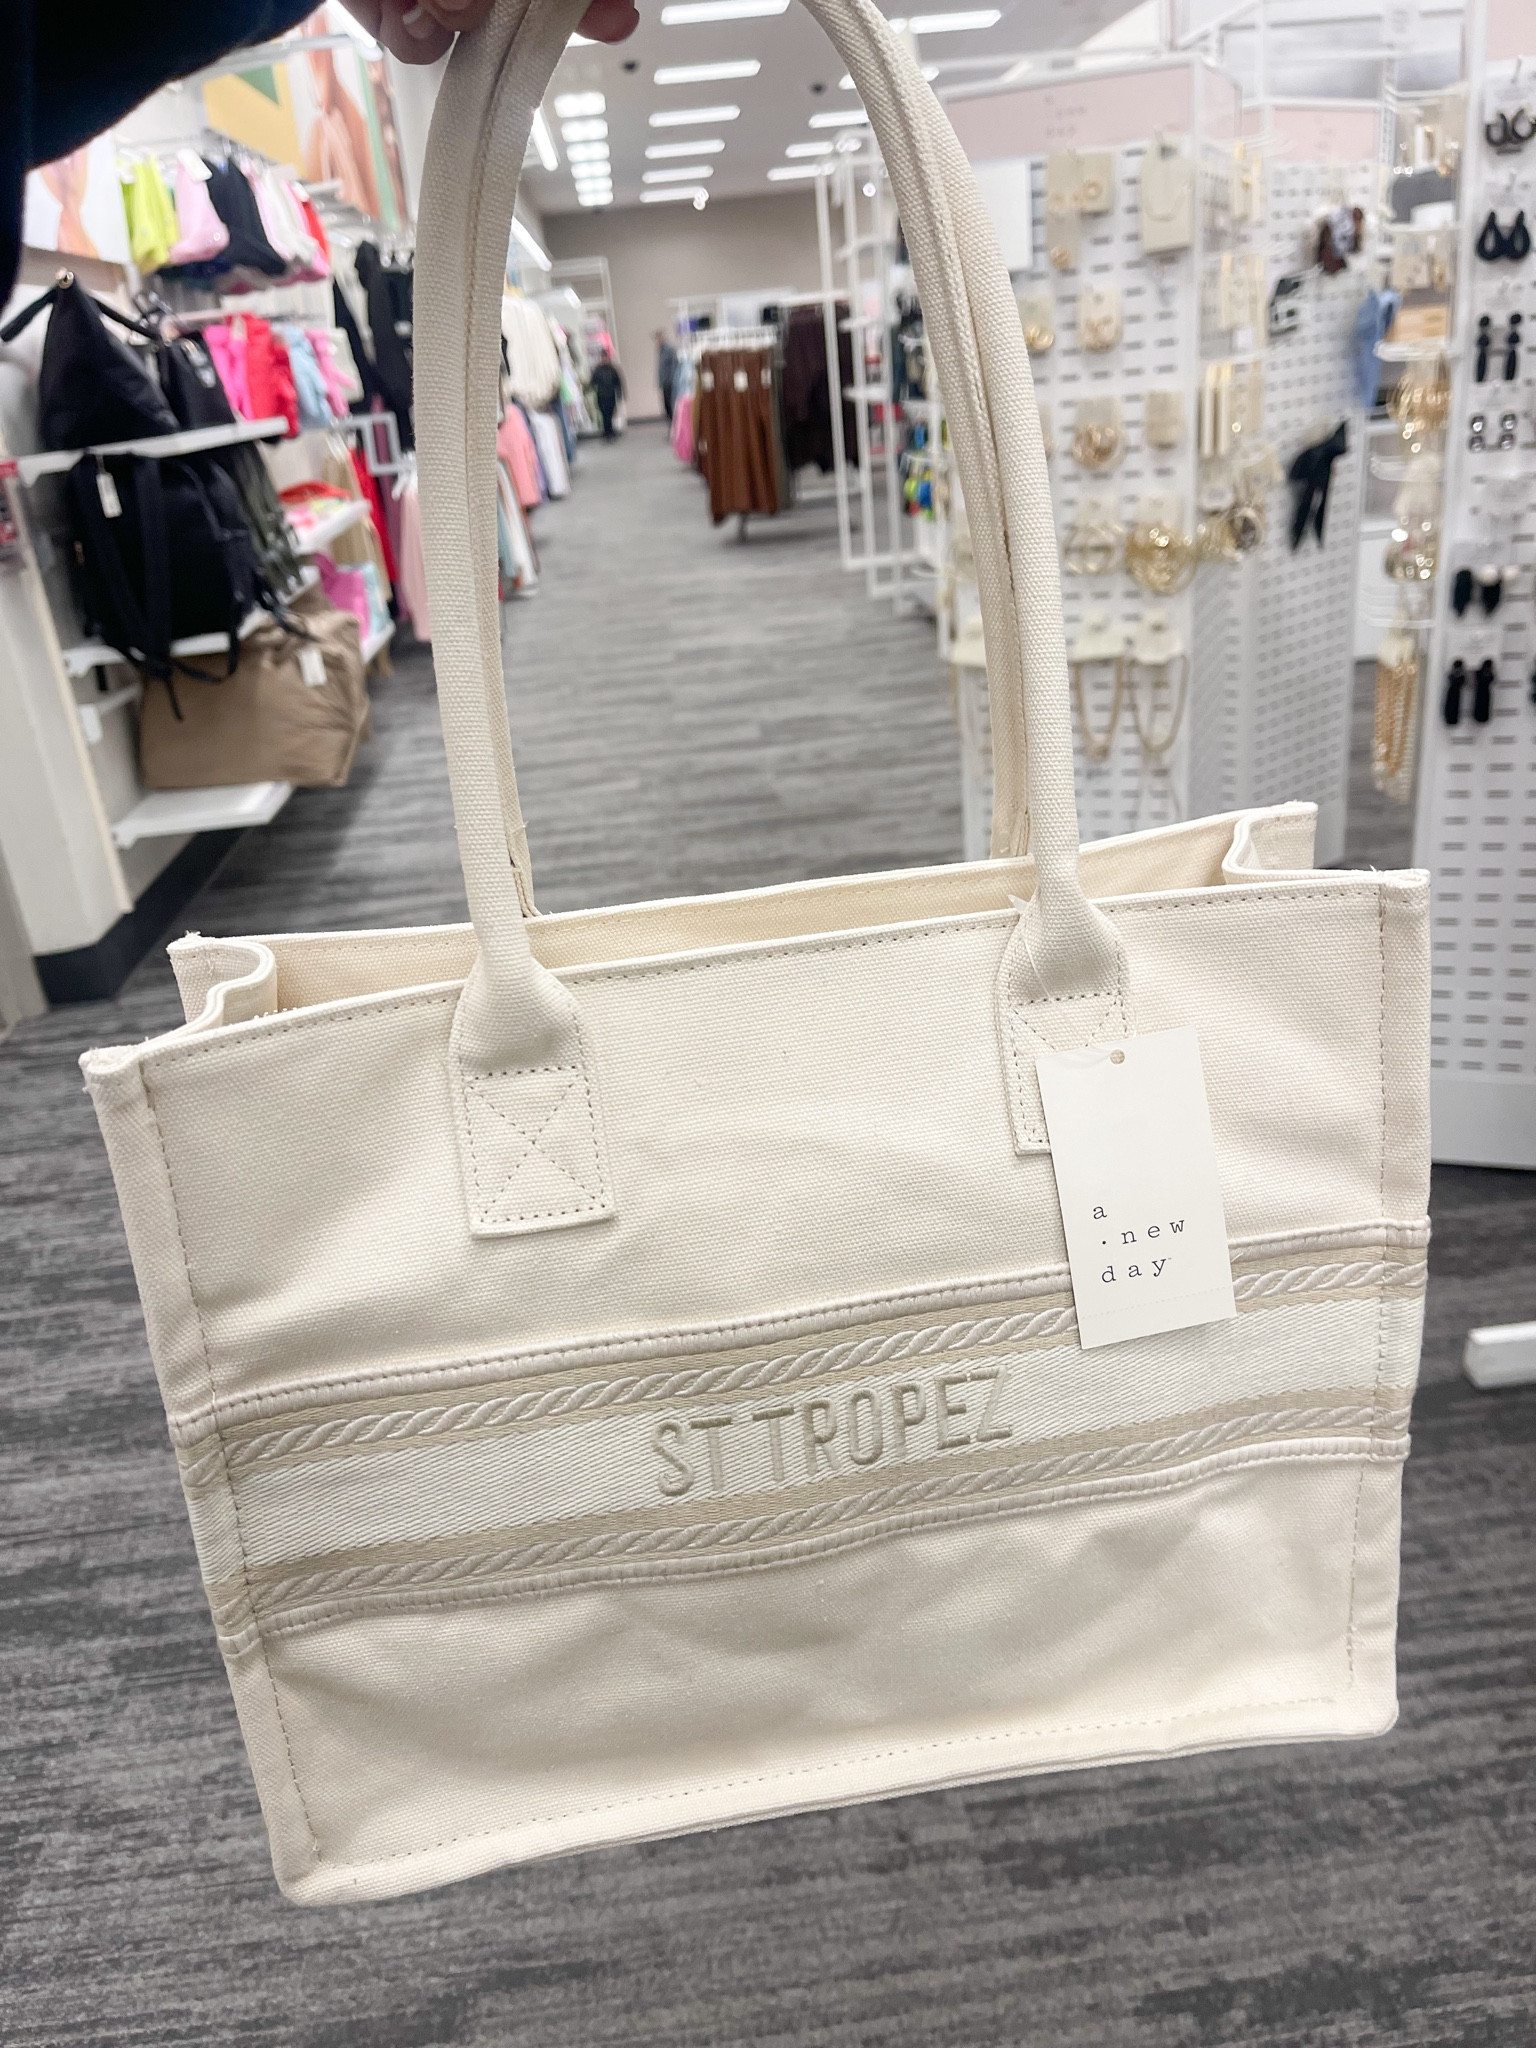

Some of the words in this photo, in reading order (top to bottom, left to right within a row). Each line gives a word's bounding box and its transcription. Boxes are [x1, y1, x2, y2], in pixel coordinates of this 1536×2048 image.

[1092, 1205, 1108, 1220] a
[1101, 1257, 1168, 1283] day
[652, 1416, 733, 1497] ST
[752, 1365, 1013, 1482] TROPEZ
